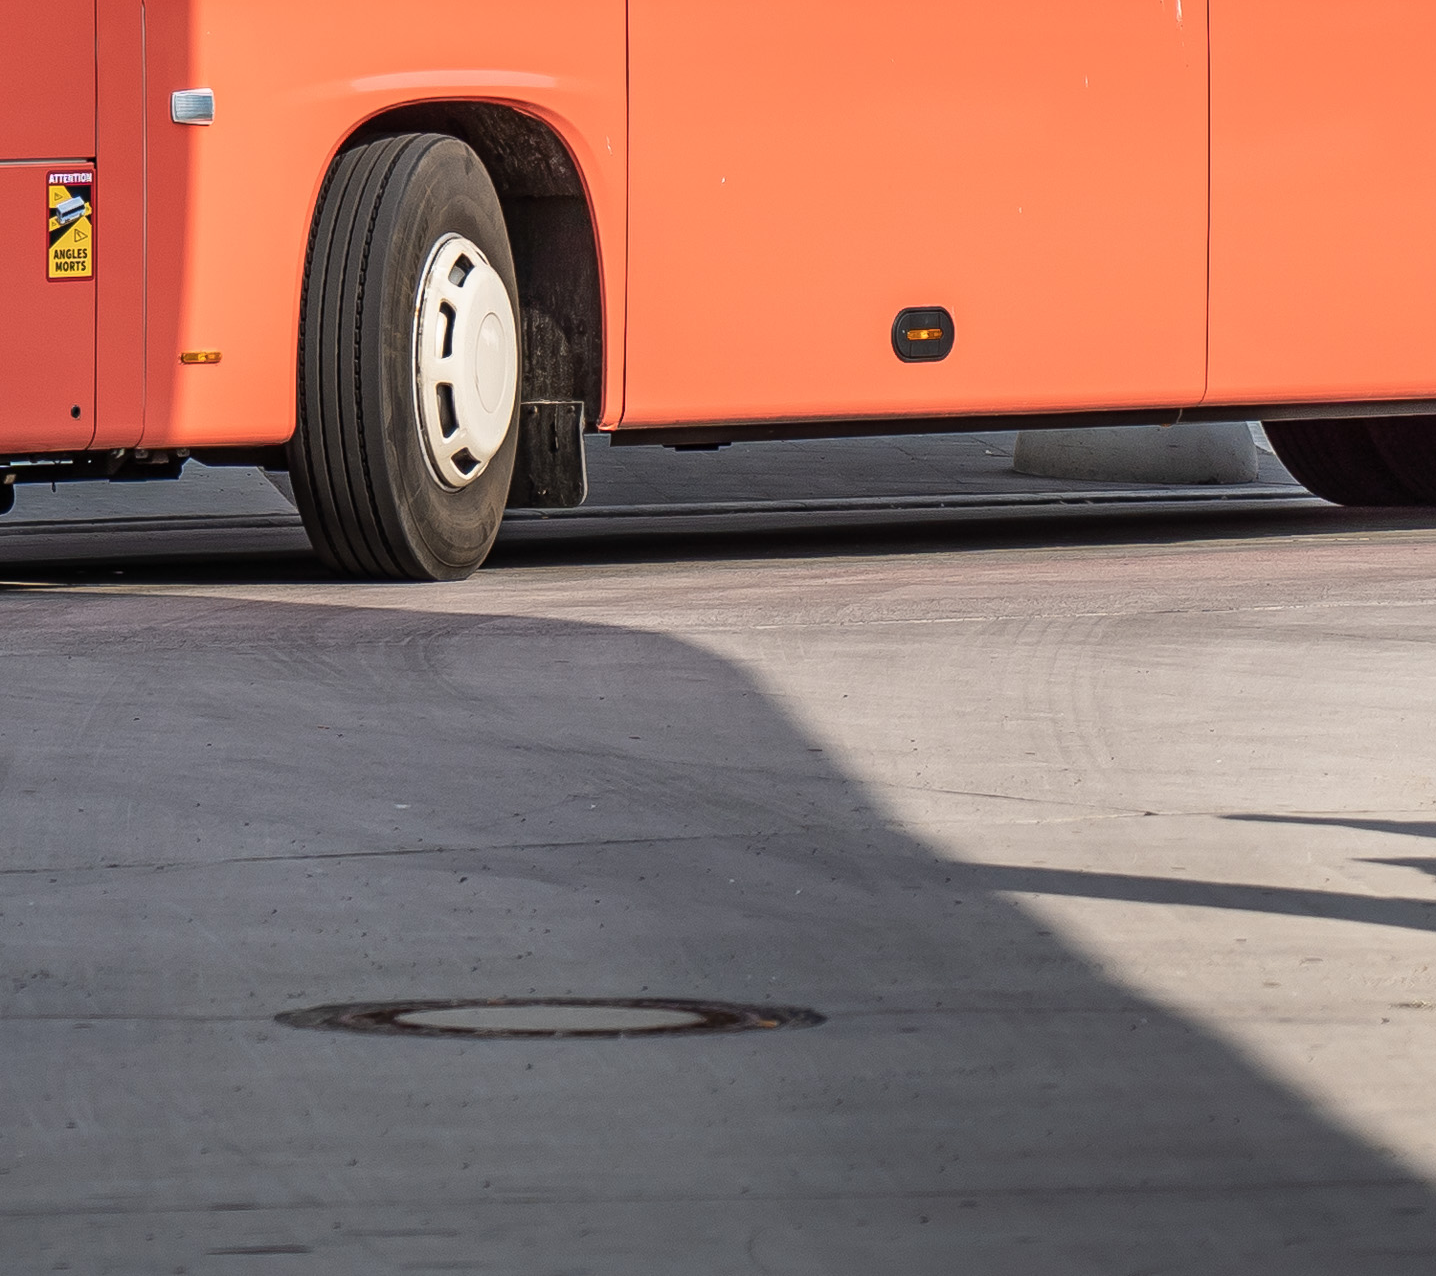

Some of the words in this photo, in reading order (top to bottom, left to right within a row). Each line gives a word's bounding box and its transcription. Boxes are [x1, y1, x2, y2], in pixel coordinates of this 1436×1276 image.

[48, 173, 93, 184] ATTENTION
[53, 248, 88, 260] ANGLES
[55, 260, 87, 272] MORTS
